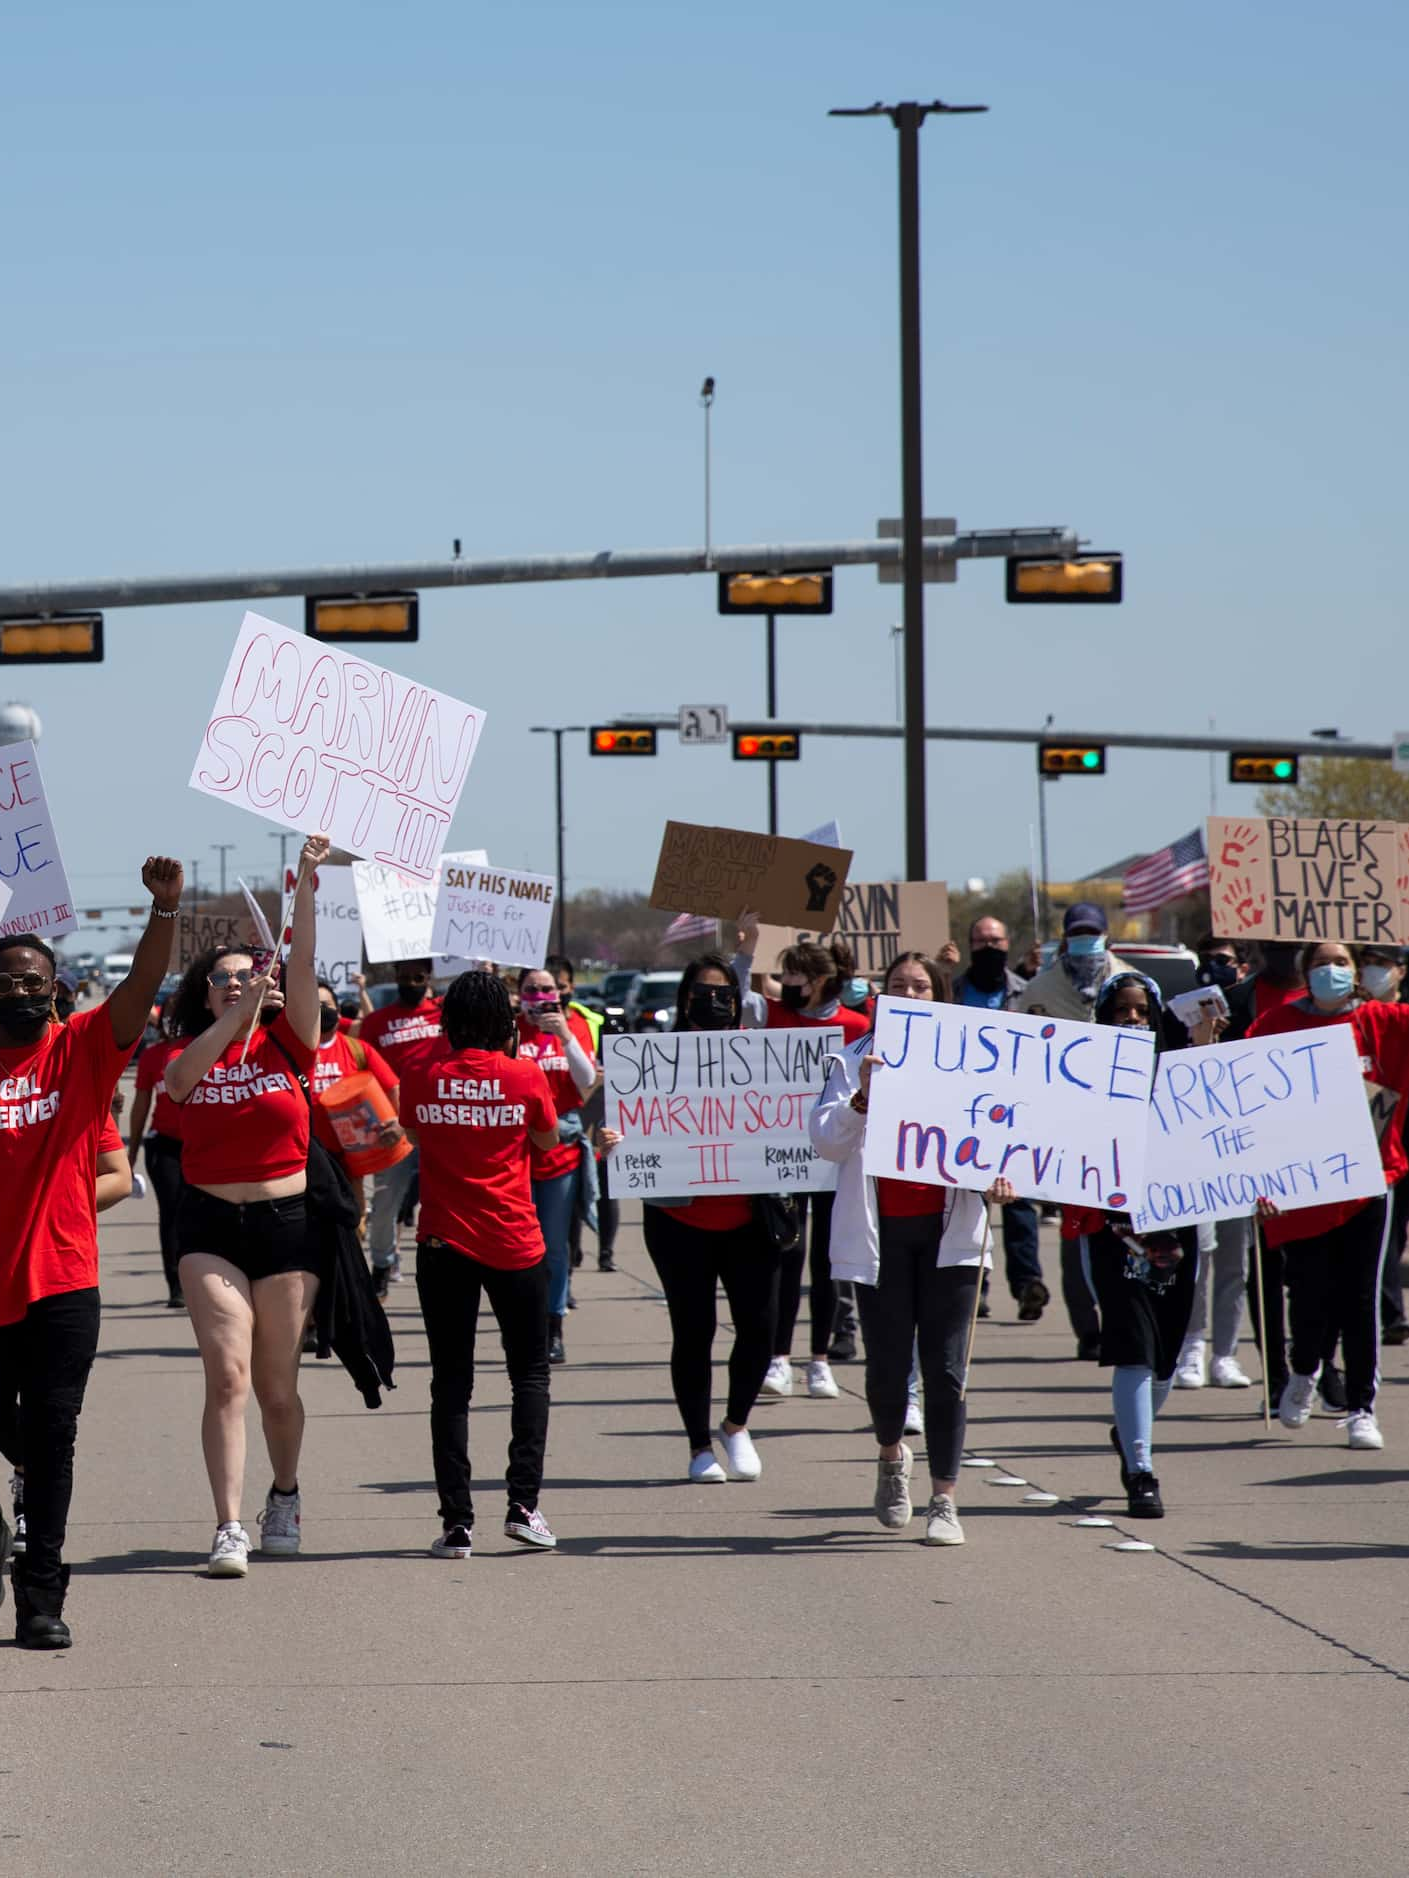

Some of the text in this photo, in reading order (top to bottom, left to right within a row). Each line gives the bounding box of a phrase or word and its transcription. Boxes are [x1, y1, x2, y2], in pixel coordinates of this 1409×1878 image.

[231, 632, 476, 805] MARVIN
[198, 715, 452, 880] SCOTT III
[671, 829, 778, 865] MARVIN
[1266, 818, 1379, 864] BLACK
[446, 868, 476, 890] SAY
[479, 873, 505, 895] HIS
[508, 878, 553, 904] NAME
[660, 855, 767, 892] SCOTT
[1271, 858, 1384, 901] LIVES
[180, 913, 241, 938] BLACK
[447, 895, 526, 921] Justice for
[1273, 898, 1396, 944] MATTER
[387, 1014, 430, 1031] LEGAL
[201, 1061, 264, 1084] LEGAL
[610, 1035, 680, 1095] SAY
[696, 1035, 753, 1089] HIS
[185, 1072, 293, 1106] BSERVER
[437, 1078, 507, 1101] LEGAL
[415, 1103, 528, 1128] OBSERVER
[618, 1095, 737, 1137] MARVIN
[963, 1093, 1030, 1129] for
[1201, 1124, 1256, 1159] THE
[628, 1171, 657, 1189] 3:19
[688, 1142, 740, 1185] III
[776, 1165, 809, 1181] 12:19
[1322, 1152, 1360, 1185] 7
